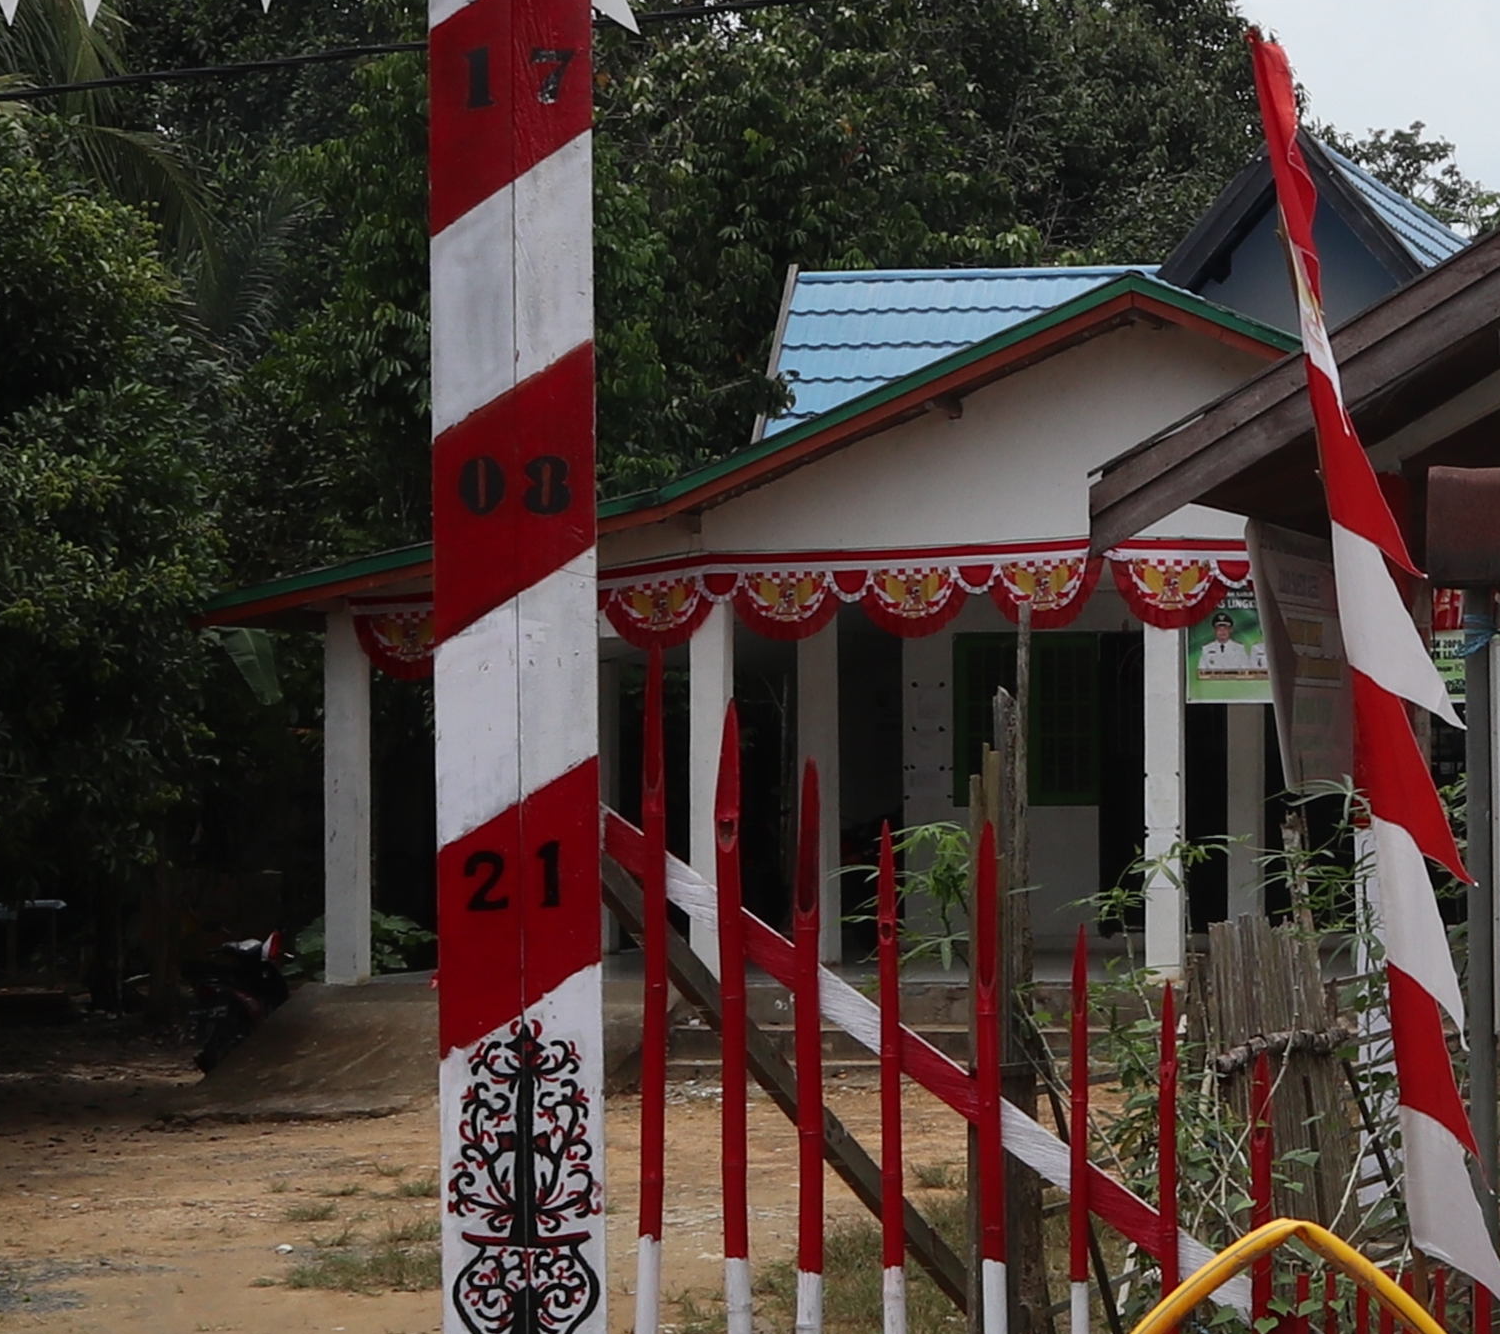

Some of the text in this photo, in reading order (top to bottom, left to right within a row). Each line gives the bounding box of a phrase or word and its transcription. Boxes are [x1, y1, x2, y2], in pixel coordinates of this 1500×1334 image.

[462, 46, 576, 109] 17
[458, 454, 573, 517] 08
[462, 840, 561, 912] 21
